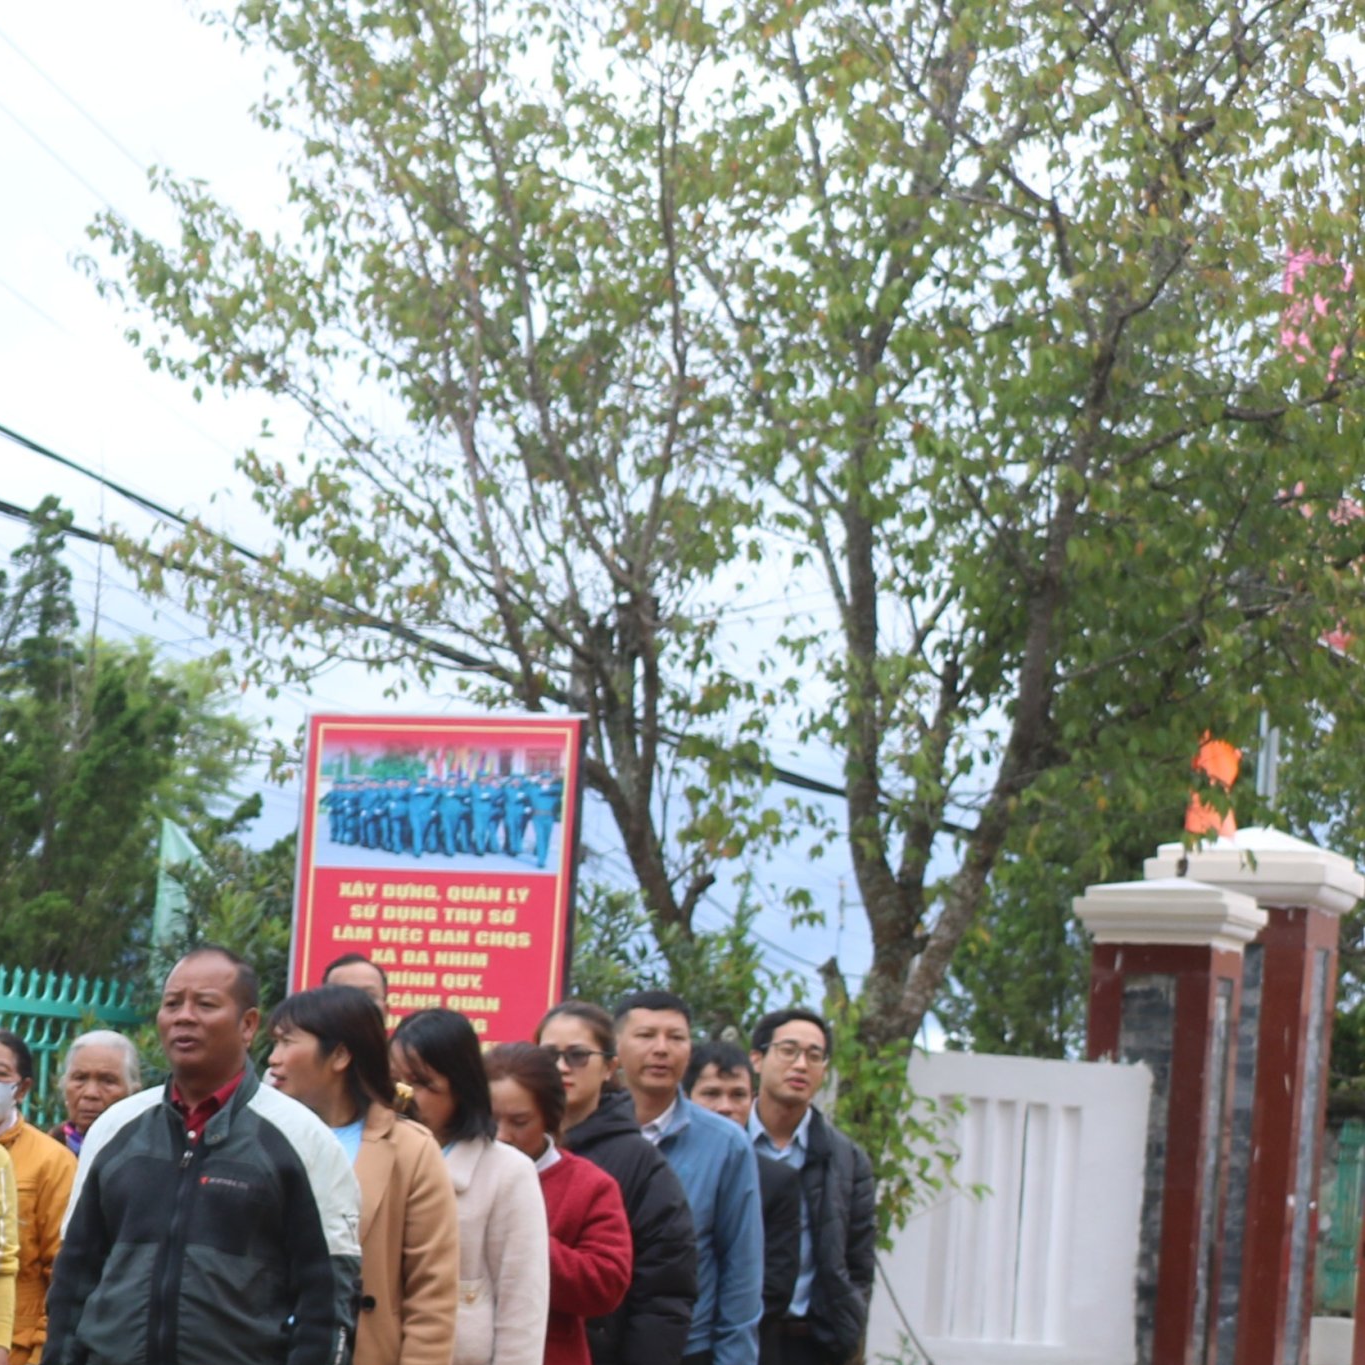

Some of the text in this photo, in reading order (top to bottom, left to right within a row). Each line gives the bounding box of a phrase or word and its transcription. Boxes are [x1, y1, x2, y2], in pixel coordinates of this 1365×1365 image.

[339, 880, 377, 898] XÂY
[447, 884, 501, 902] QUẢN
[382, 905, 438, 922] DỤNG
[443, 907, 483, 925] TRỤ
[332, 924, 531, 948] LÀM VIỆC BAN CHQS
[371, 947, 397, 965] XÃ
[434, 951, 488, 968] NHIM
[386, 969, 436, 988] HÍNH
[447, 994, 500, 1013] QUAN
